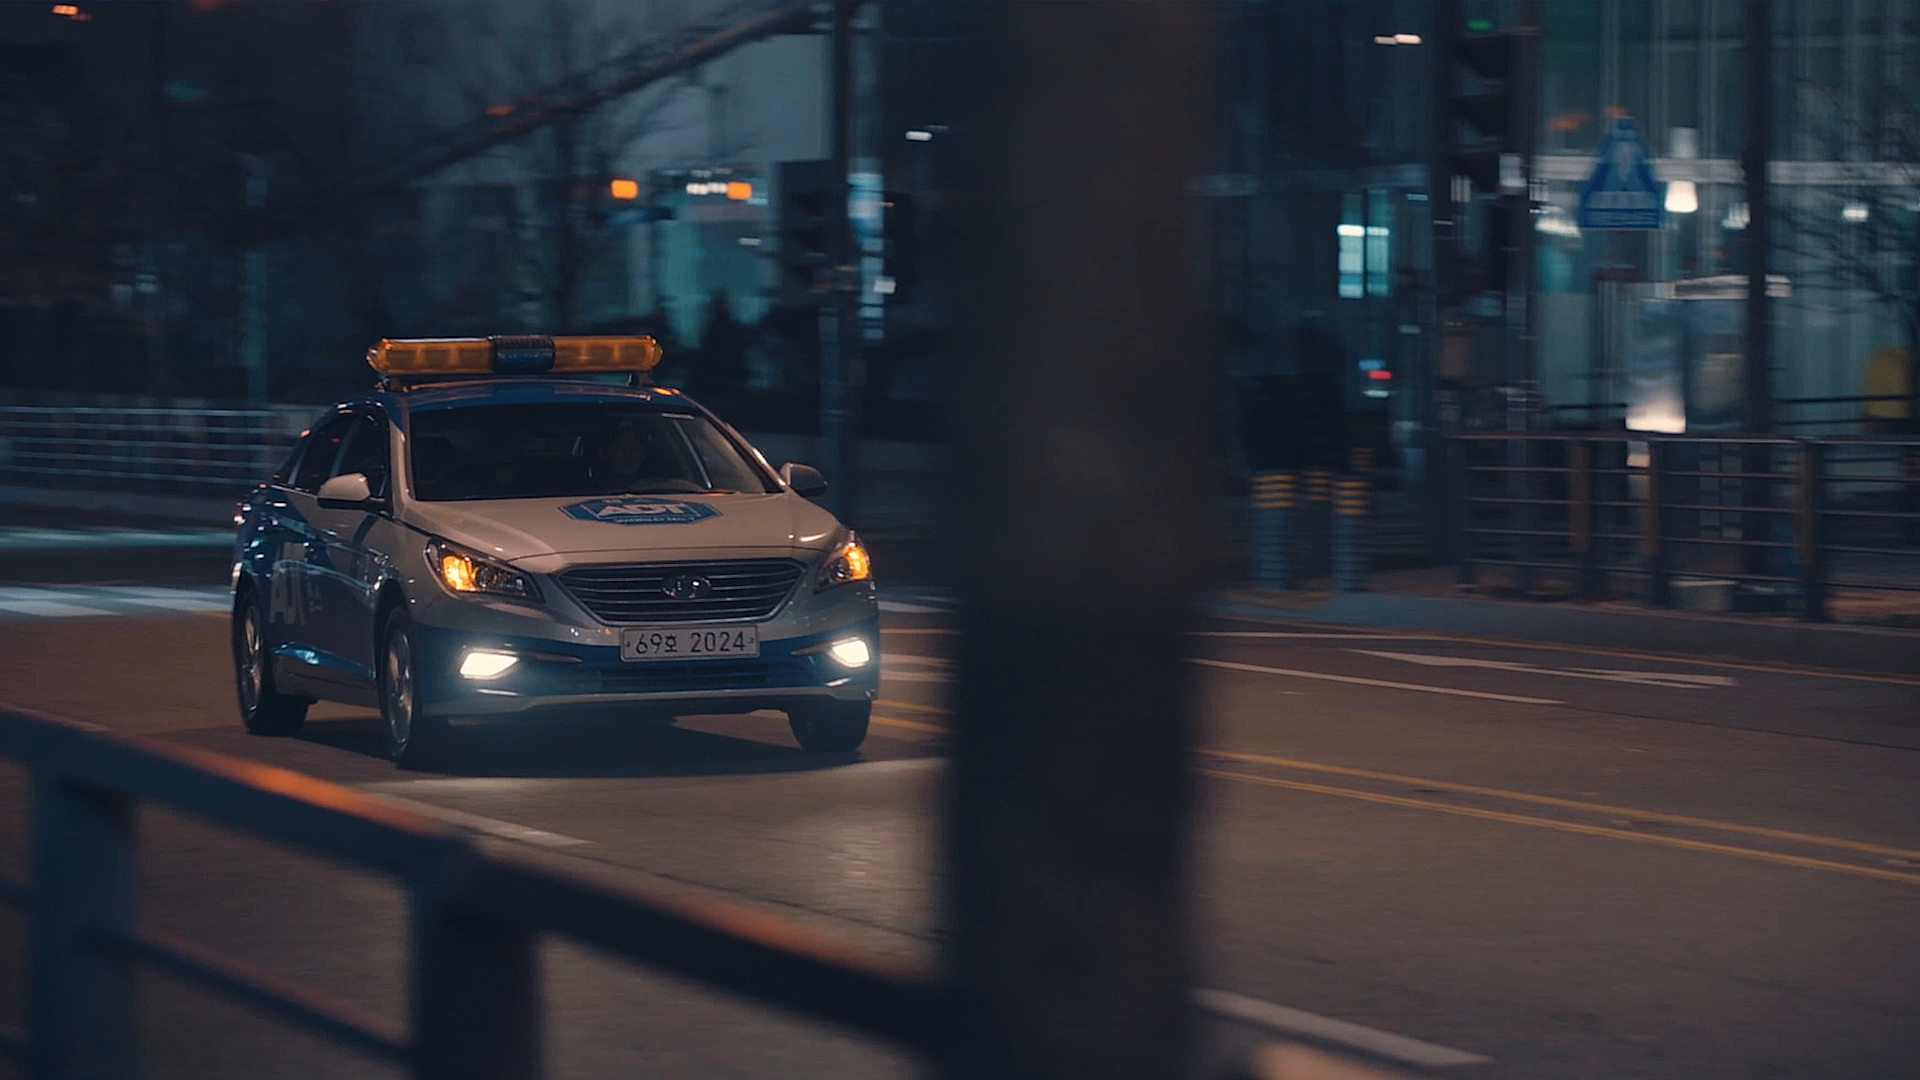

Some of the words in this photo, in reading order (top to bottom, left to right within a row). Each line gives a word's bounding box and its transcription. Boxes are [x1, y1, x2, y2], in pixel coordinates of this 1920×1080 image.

[598, 504, 684, 516] ADT
[635, 633, 678, 654] 69호
[690, 631, 746, 653] 2024
